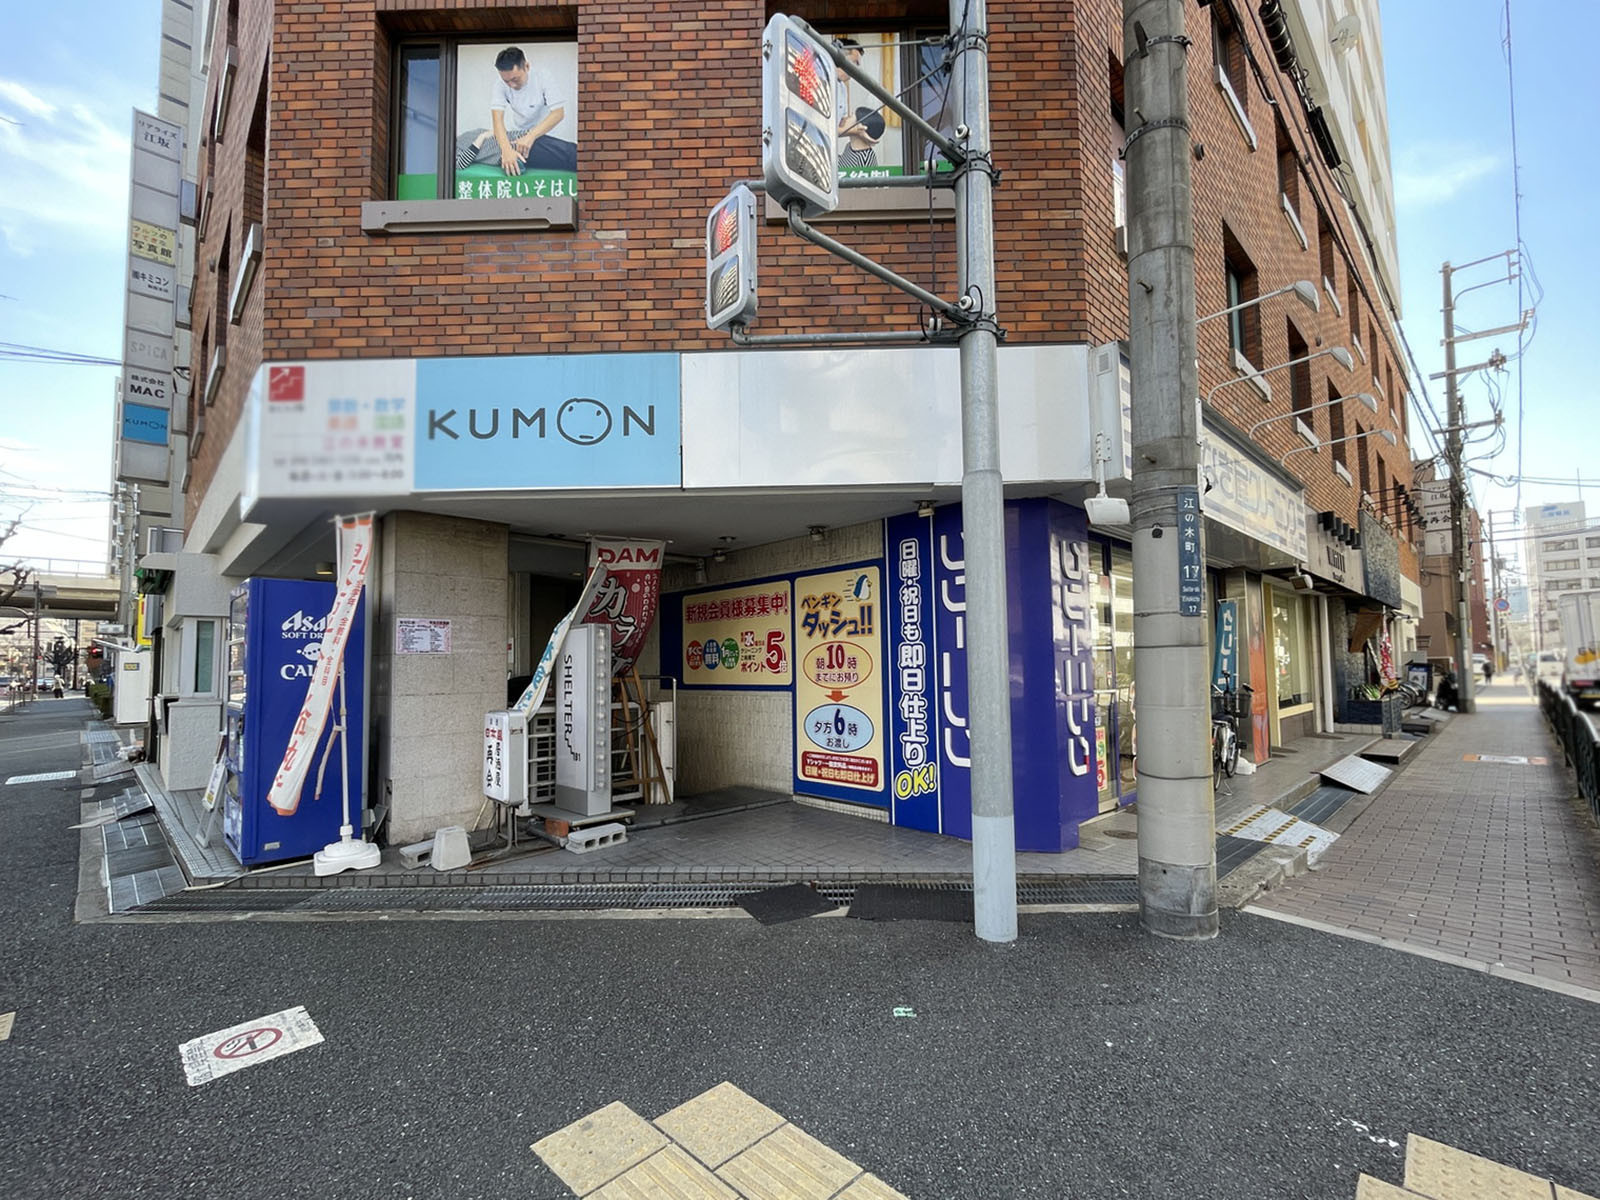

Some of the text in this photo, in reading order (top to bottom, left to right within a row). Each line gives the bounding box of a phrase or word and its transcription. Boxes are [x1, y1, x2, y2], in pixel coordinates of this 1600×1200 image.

[144, 132, 170, 149] 江坂
[458, 179, 578, 200] 整体院いそはし
[132, 240, 172, 258] 写真館
[131, 375, 164, 386] 株式会社
[130, 384, 165, 399] MAC
[125, 418, 168, 431] KUMON
[428, 397, 655, 446] KUMON
[1183, 498, 1195, 553] 江の木町
[597, 547, 660, 564] DAM
[1183, 565, 1199, 579] 17
[741, 662, 766, 673] ポイント
[563, 655, 574, 737] SHELTER
[814, 708, 858, 736] 夕方6時
[827, 738, 850, 749] お渡し
[895, 763, 937, 800] OK!
